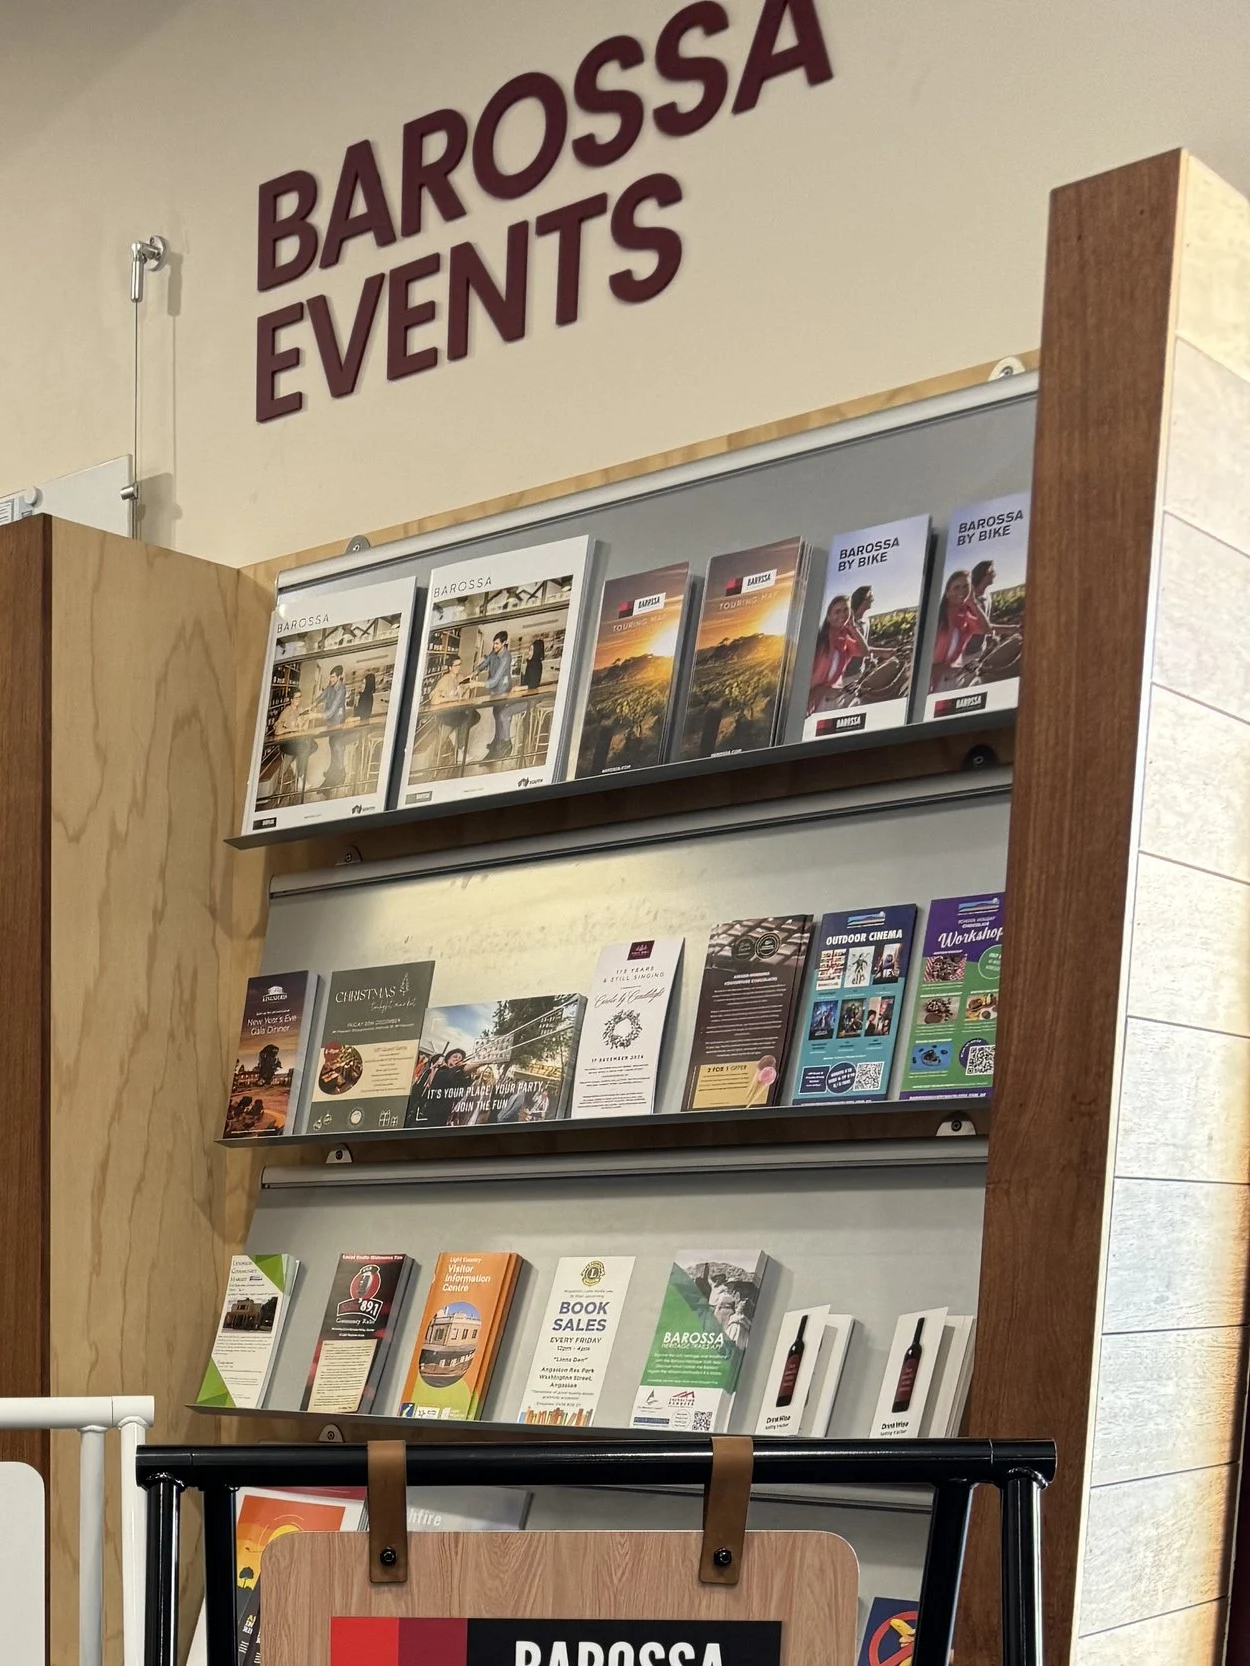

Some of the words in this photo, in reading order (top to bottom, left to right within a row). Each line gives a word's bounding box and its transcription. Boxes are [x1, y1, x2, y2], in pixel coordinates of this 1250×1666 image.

[257, 0, 833, 292] BAROSSA
[256, 173, 683, 423] EVENTS
[958, 509, 1024, 533] BAROSSA
[957, 533, 975, 547] BY
[978, 524, 1011, 542] BIKE
[839, 536, 900, 560] BAROSSA
[837, 559, 854, 572] BY
[857, 551, 888, 568] BIKE
[433, 576, 492, 598] BAROSSA
[719, 596, 758, 611] TOURING
[277, 613, 329, 634] BAROSSA
[613, 618, 648, 632] TOURING
[826, 933, 867, 946] OUTDOOR
[868, 929, 903, 941] CINEMA
[335, 986, 396, 1003] CHRISTMAS
[427, 1088, 442, 1100] IT'S
[443, 1087, 464, 1099] YOUR
[495, 1083, 516, 1095] YOUR
[454, 1101, 474, 1113] JOIN
[477, 1100, 491, 1111] THE
[492, 1099, 509, 1110] FUN
[448, 1264, 474, 1273] Visitor
[444, 1273, 491, 1283] Information
[442, 1283, 469, 1292] Centre
[558, 1301, 611, 1315] BOOK
[552, 1318, 607, 1332] SALES
[549, 1336, 574, 1344] EVERY
[663, 1331, 724, 1344] BAROSSA
